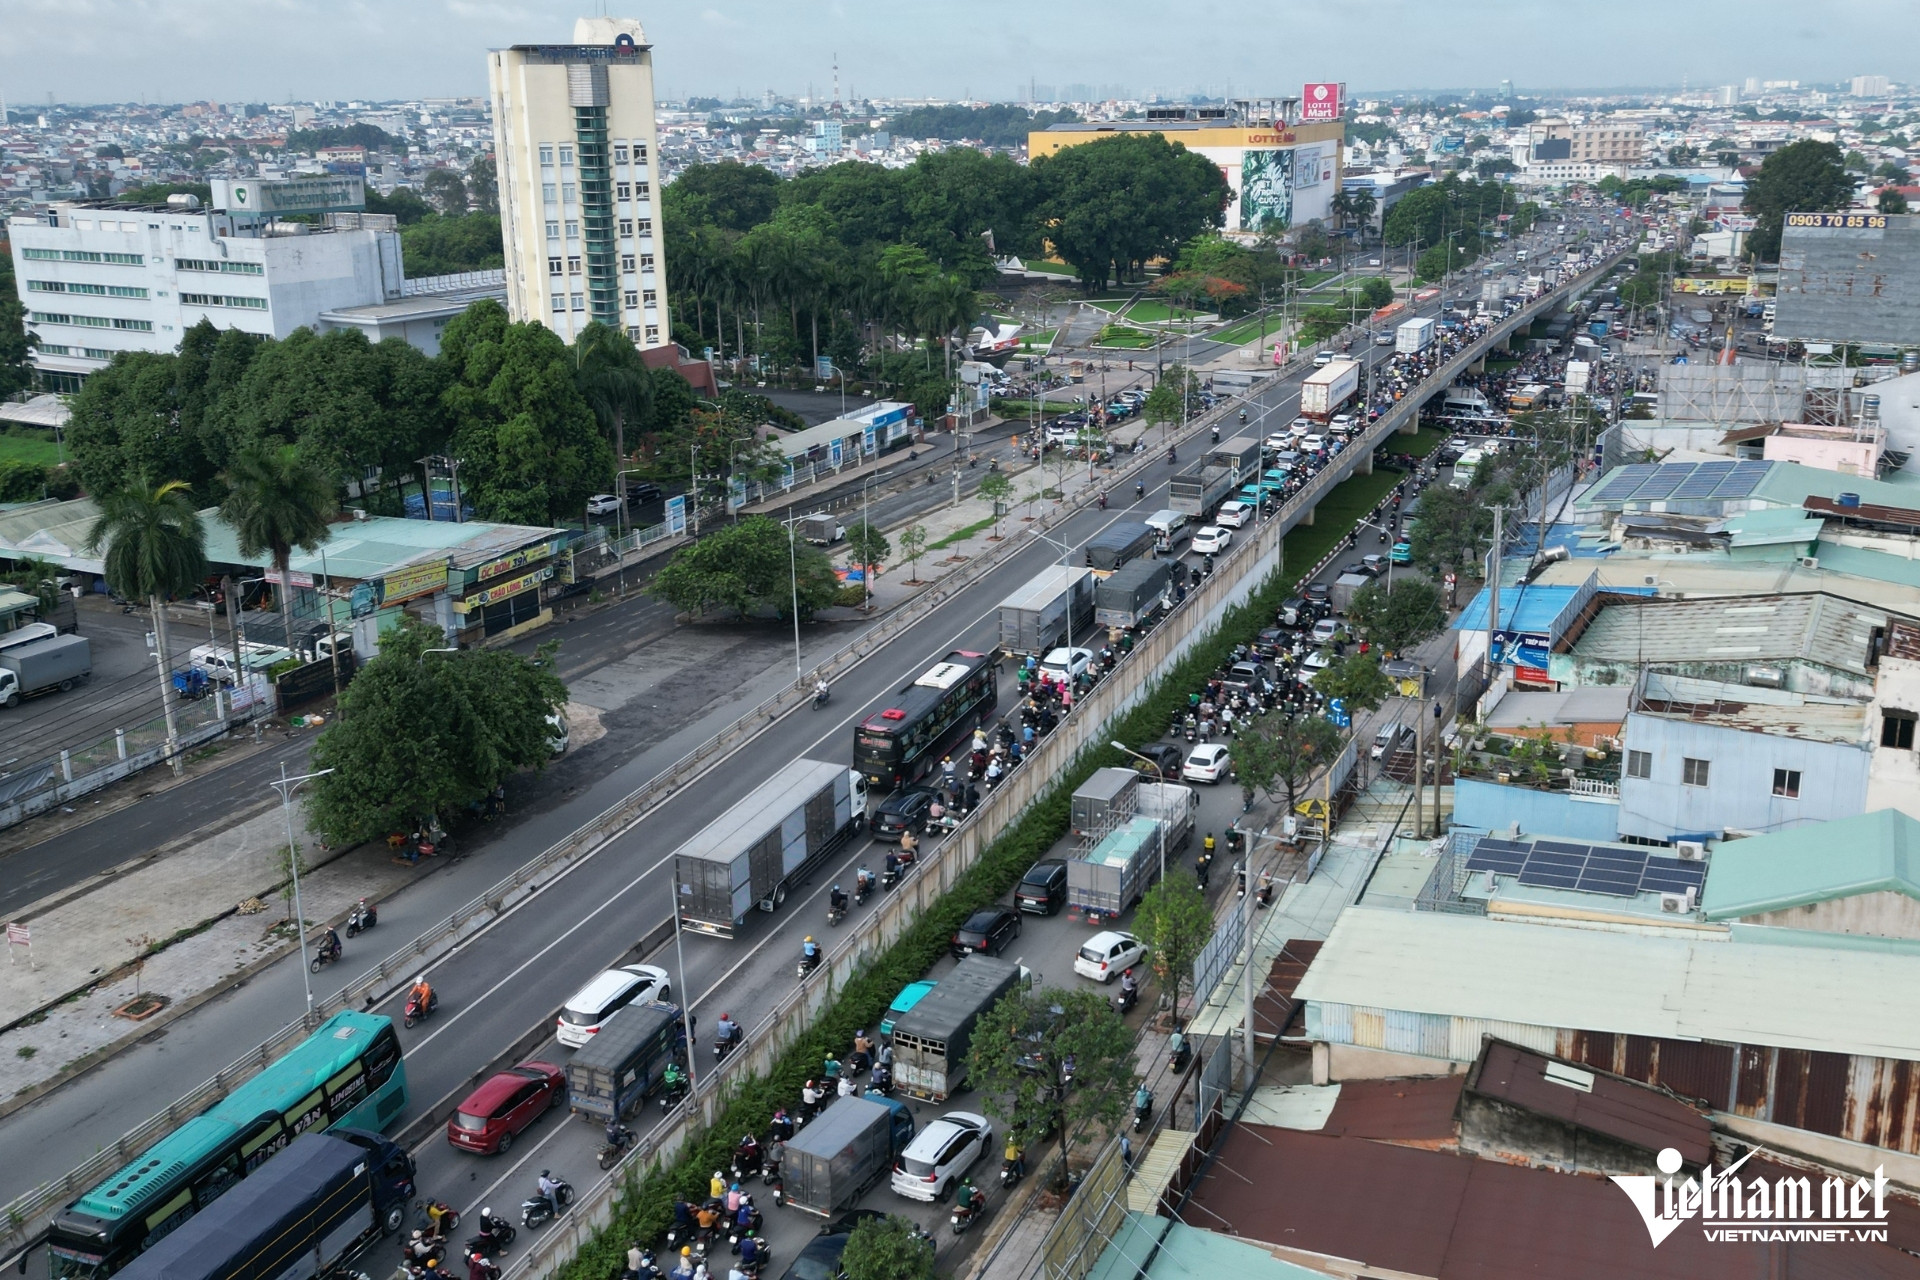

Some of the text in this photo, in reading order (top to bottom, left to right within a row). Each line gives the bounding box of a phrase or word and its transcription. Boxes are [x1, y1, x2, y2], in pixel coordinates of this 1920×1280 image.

[1307, 108, 1333, 117] Mart
[1248, 134, 1282, 143] LOTTE
[1788, 215, 1886, 228] 0903 70 85 96
